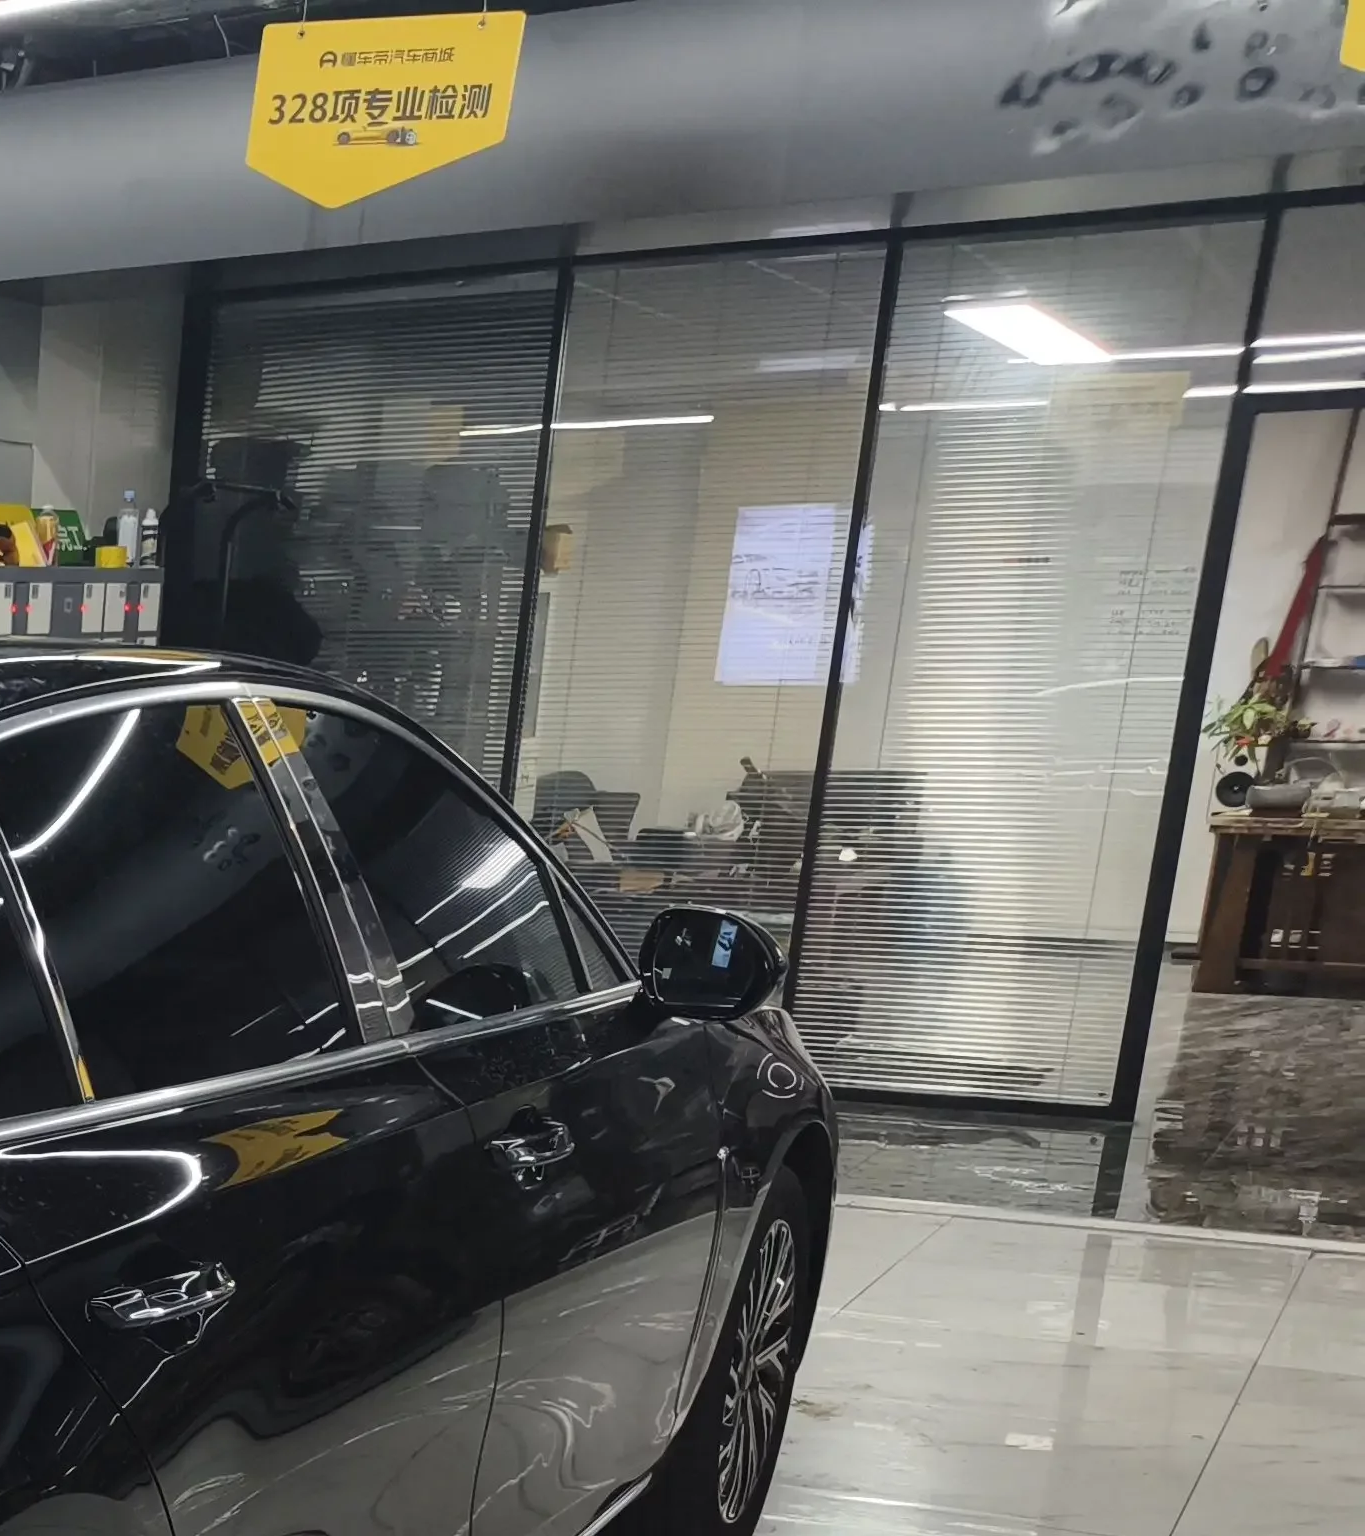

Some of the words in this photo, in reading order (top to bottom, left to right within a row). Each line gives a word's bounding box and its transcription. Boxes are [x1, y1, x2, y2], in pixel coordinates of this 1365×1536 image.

[268, 83, 493, 125] 328项专业检测
